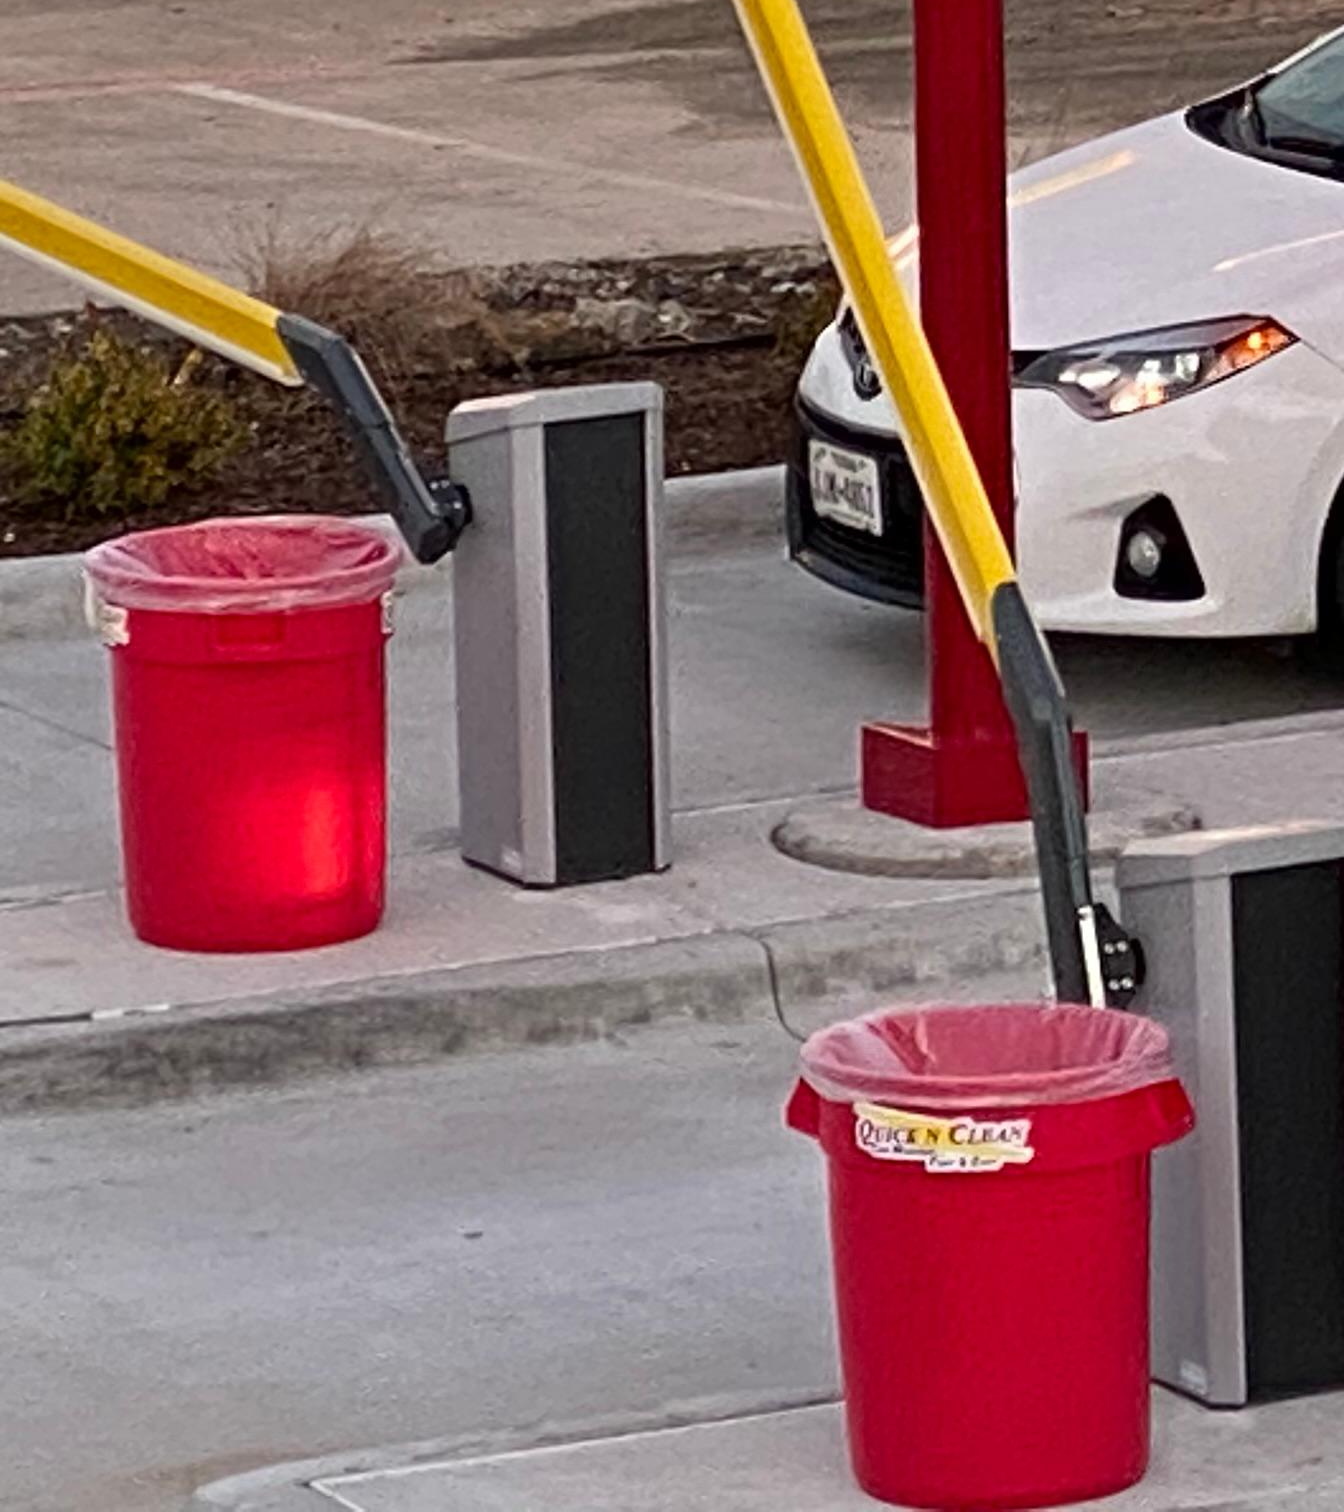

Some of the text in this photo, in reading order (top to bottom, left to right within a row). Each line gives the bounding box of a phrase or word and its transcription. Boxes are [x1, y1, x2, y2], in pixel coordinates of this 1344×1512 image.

[859, 1119, 1025, 1147] QUICK N CLEAN
